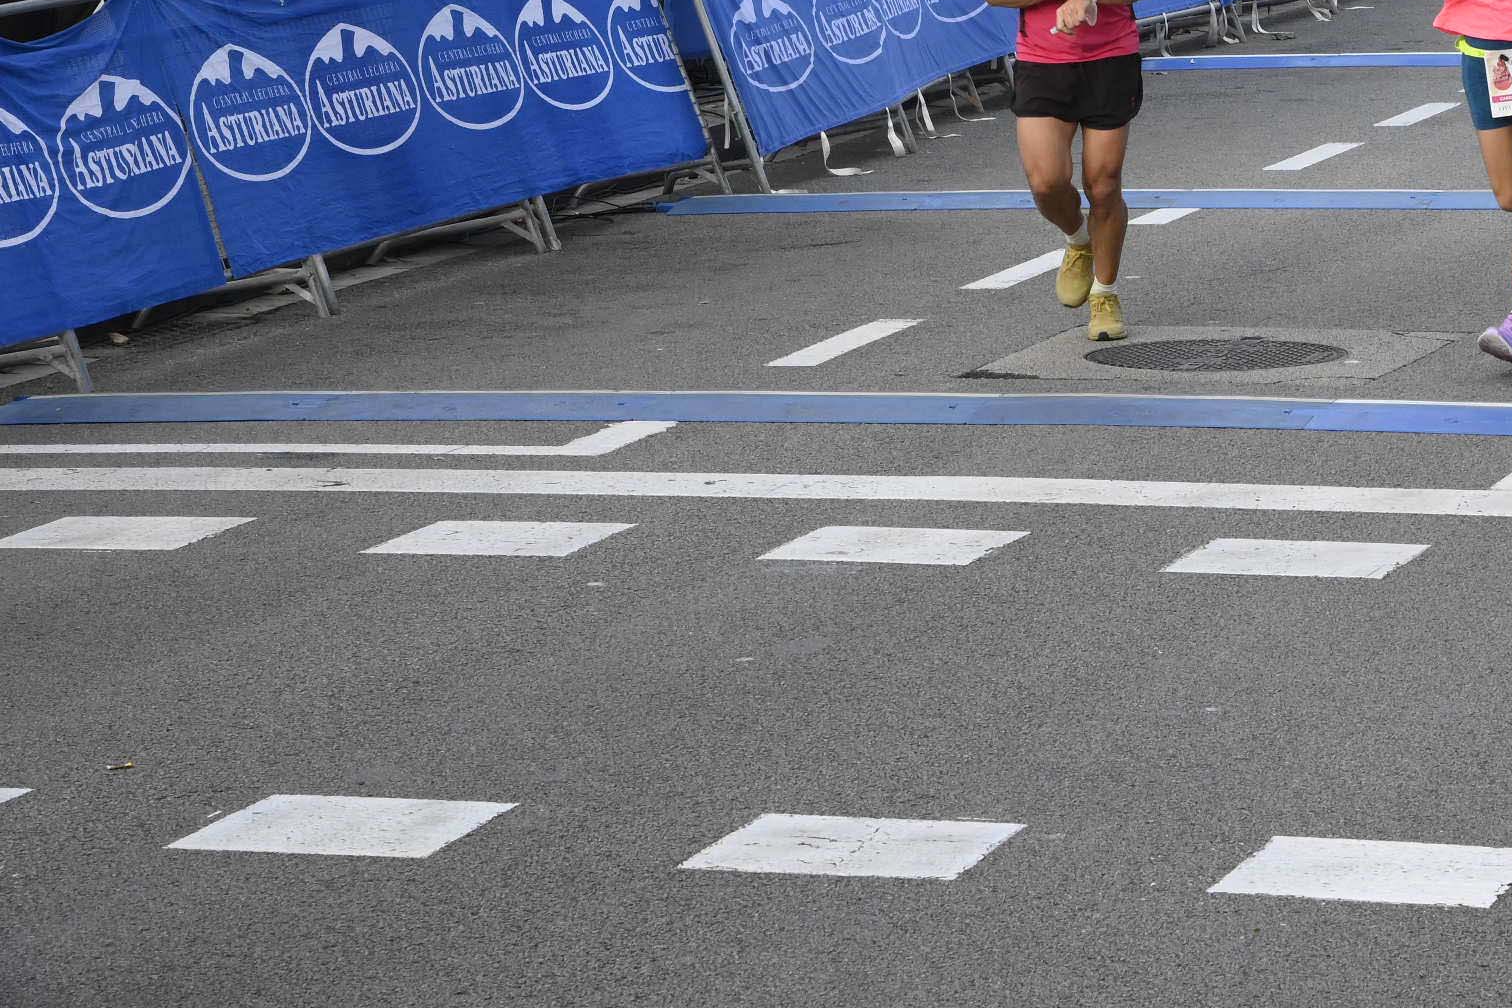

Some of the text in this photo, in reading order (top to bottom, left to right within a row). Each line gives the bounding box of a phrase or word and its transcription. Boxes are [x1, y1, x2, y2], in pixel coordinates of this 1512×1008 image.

[438, 42, 504, 64] CENTRAL LECHERA
[532, 26, 592, 47] CENTRAL LECHERA
[326, 60, 400, 85] CENTRAL LECHERA
[430, 56, 519, 103] ASTURIANA
[524, 39, 609, 86] ASTURIANA
[213, 86, 290, 109] CENTRAL LECHERA
[317, 76, 417, 129] ASTURIANA
[80, 127, 123, 143] CENTRAL
[202, 102, 304, 154] ASTURIANA
[70, 130, 182, 191] ASTURIANA
